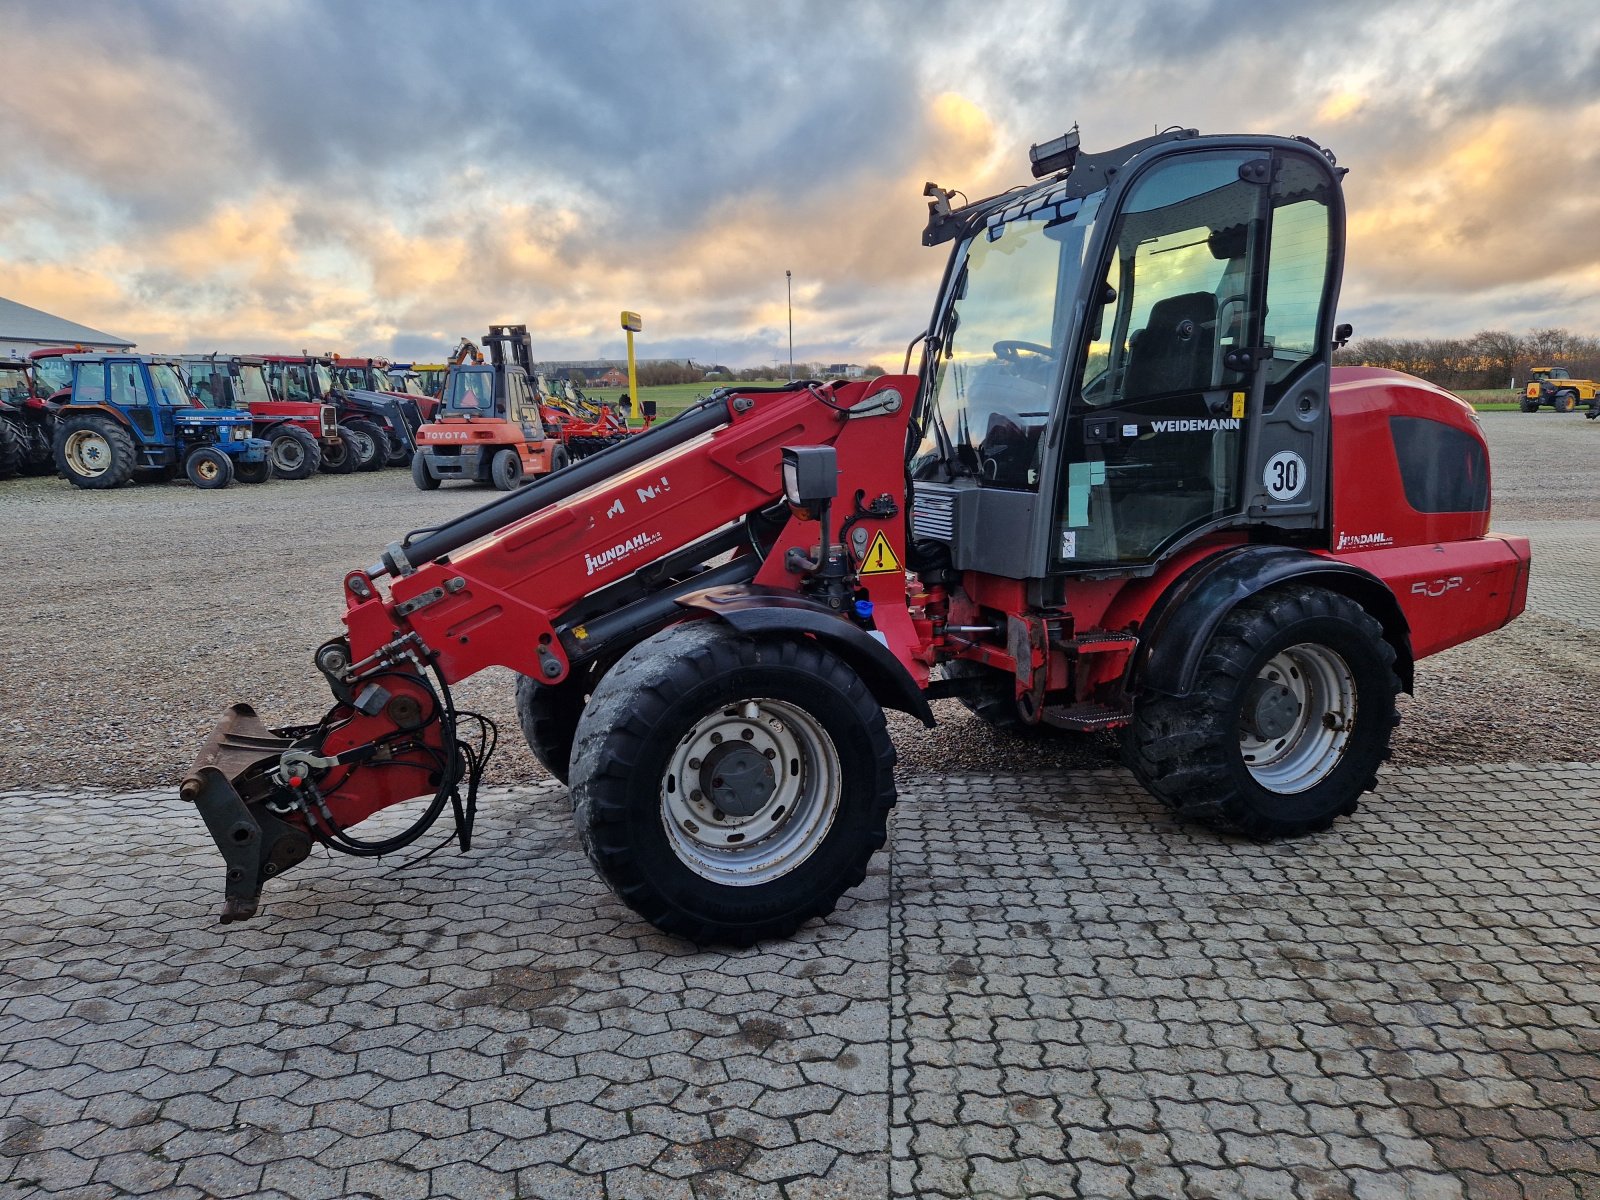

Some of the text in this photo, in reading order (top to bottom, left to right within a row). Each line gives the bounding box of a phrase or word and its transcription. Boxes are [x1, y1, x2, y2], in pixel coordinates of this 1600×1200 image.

[1151, 418, 1240, 433] WEIDEMANN
[426, 431, 468, 440] TOYOTA
[1272, 460, 1298, 492] 30
